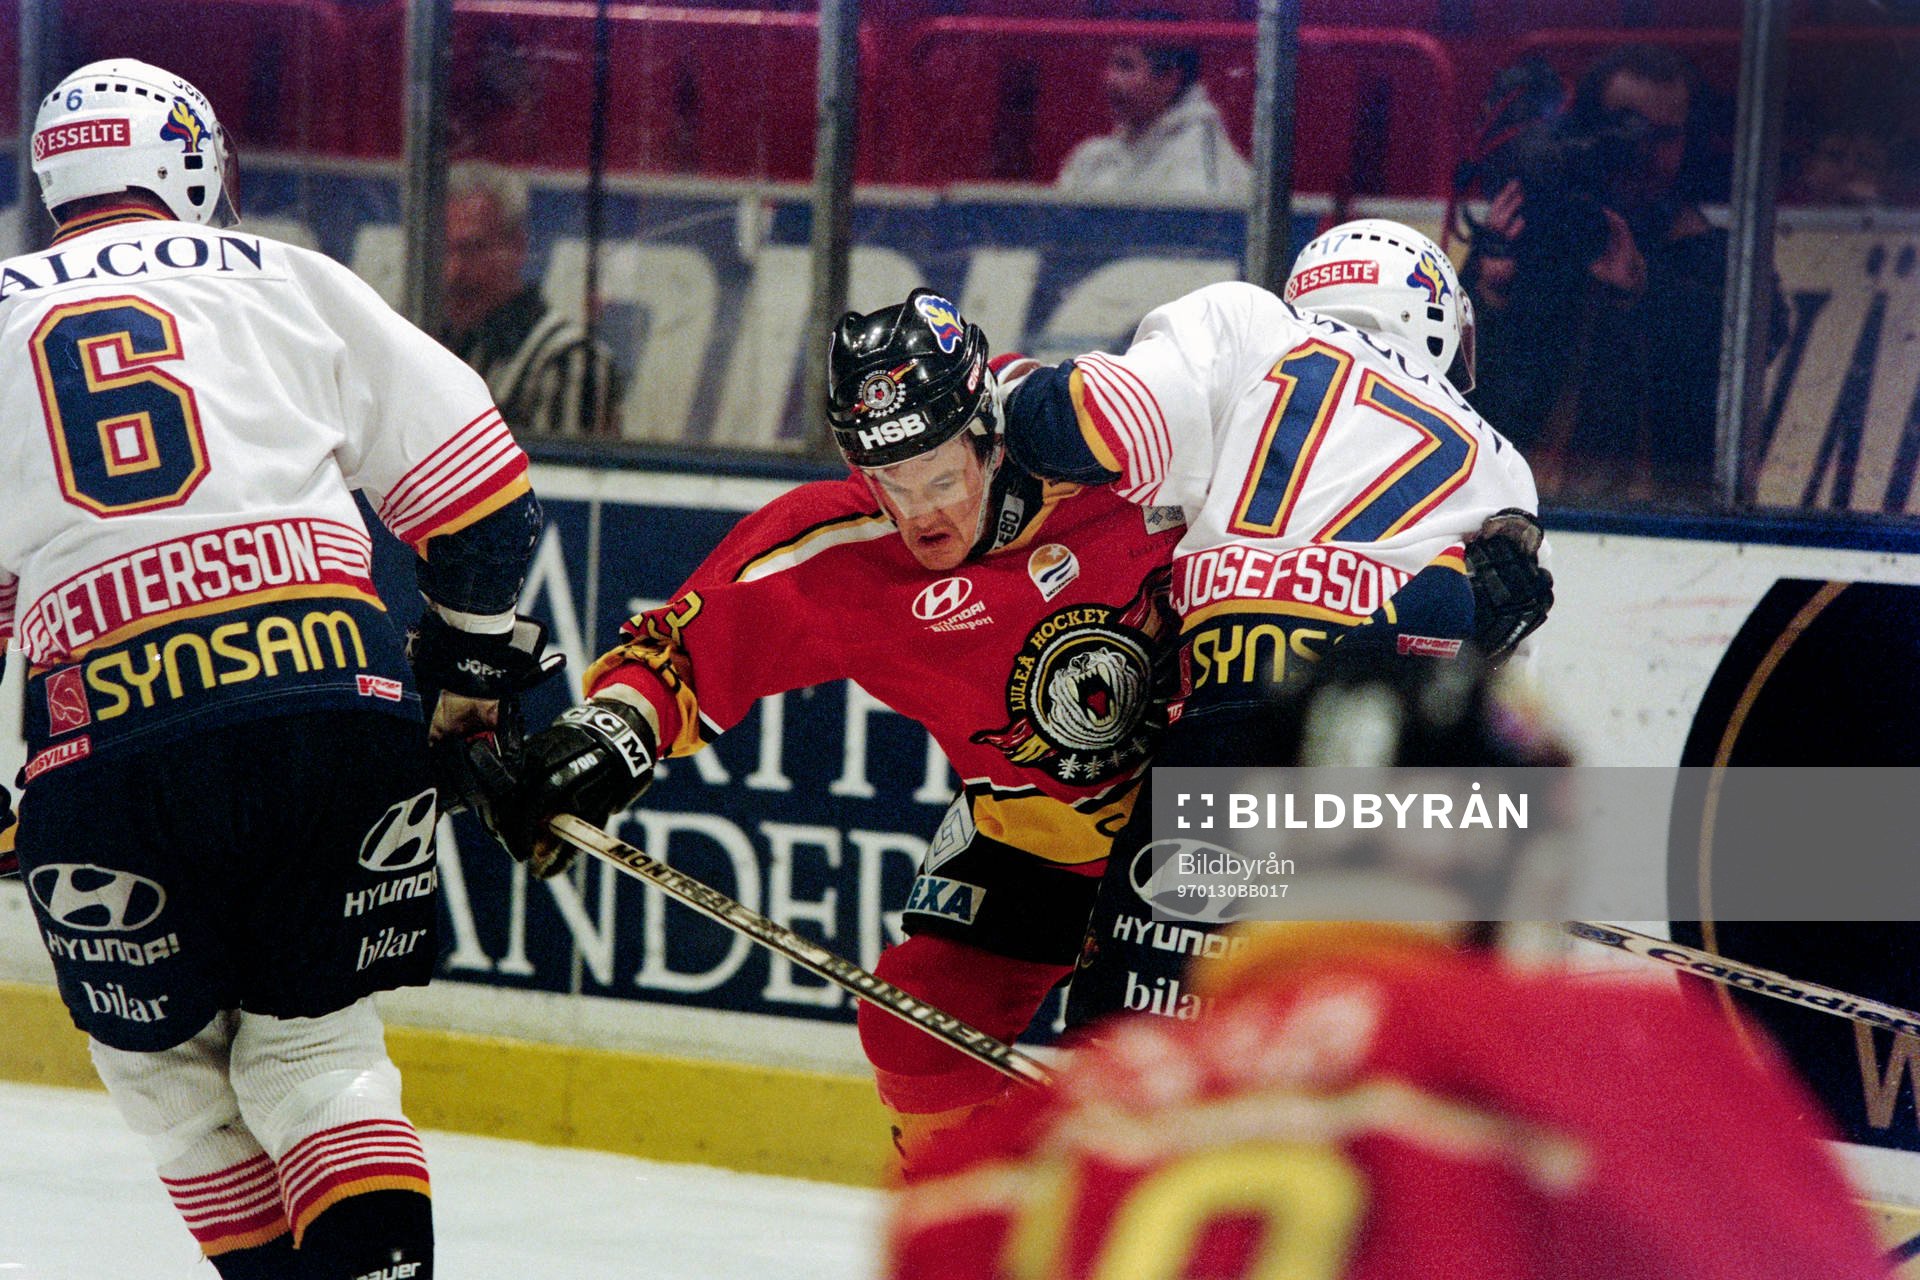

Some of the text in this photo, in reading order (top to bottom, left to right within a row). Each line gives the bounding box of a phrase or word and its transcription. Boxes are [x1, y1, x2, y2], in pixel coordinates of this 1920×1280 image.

[66, 89, 82, 111] 6
[47, 124, 124, 151] ESSELTE
[1321, 234, 1350, 255] 17
[1300, 263, 1374, 291] ESSELTE
[28, 294, 212, 519] 6
[858, 413, 926, 450] HSB
[1225, 336, 1479, 546] 17
[41, 520, 321, 652] PETTERSSON
[1174, 545, 1409, 616] JOSEFSSON
[1029, 608, 1111, 650] HOCKEY
[86, 609, 368, 721] SYNSAM
[1010, 655, 1036, 713] LULEÅ
[558, 708, 650, 773] CCM
[907, 878, 973, 921] EXA
[48, 930, 181, 966] HYUNDAI
[356, 926, 427, 972] bilar
[82, 980, 169, 1023] bilar
